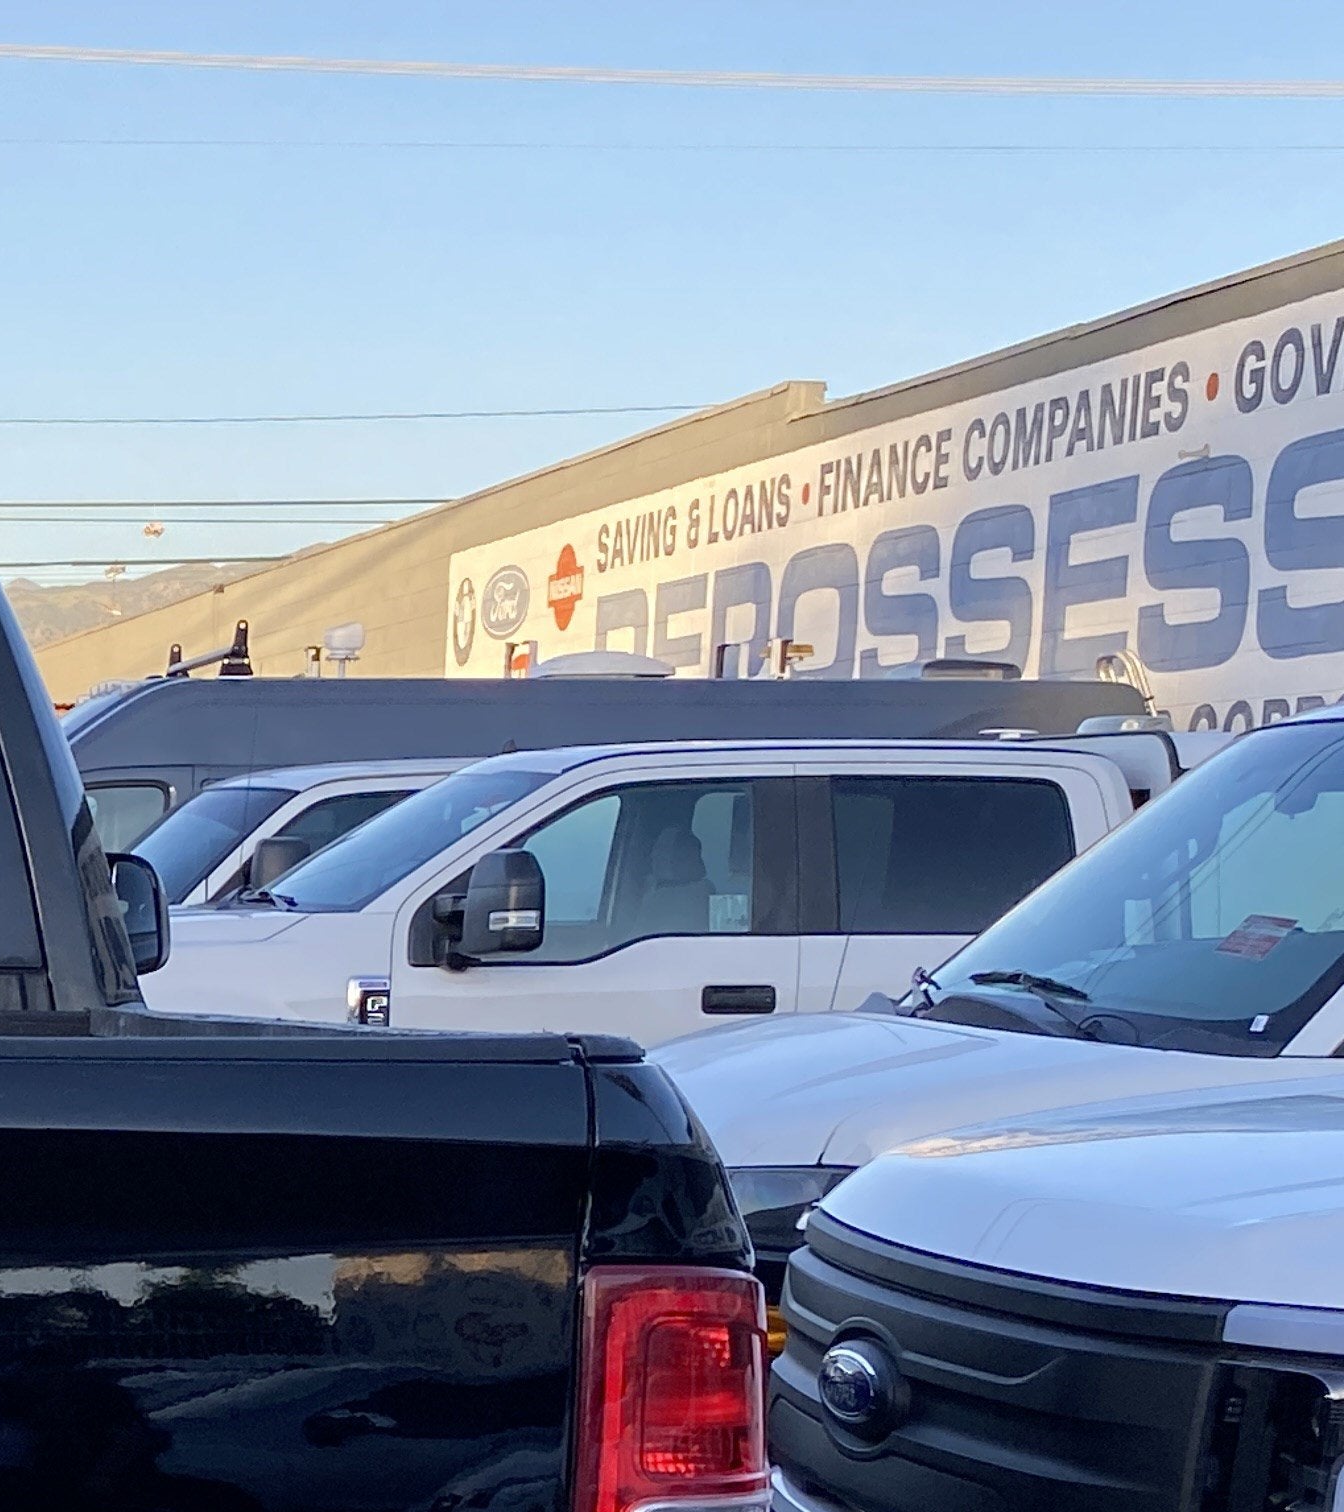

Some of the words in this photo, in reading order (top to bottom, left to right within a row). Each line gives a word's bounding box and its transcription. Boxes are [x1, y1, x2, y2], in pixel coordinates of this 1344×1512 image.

[597, 505, 677, 573] SAVING
[687, 498, 700, 549] &
[707, 473, 791, 544] LOANS
[818, 429, 950, 517] FINANCE
[963, 361, 1190, 481] COMPANIES
[1234, 316, 1344, 413] GOV
